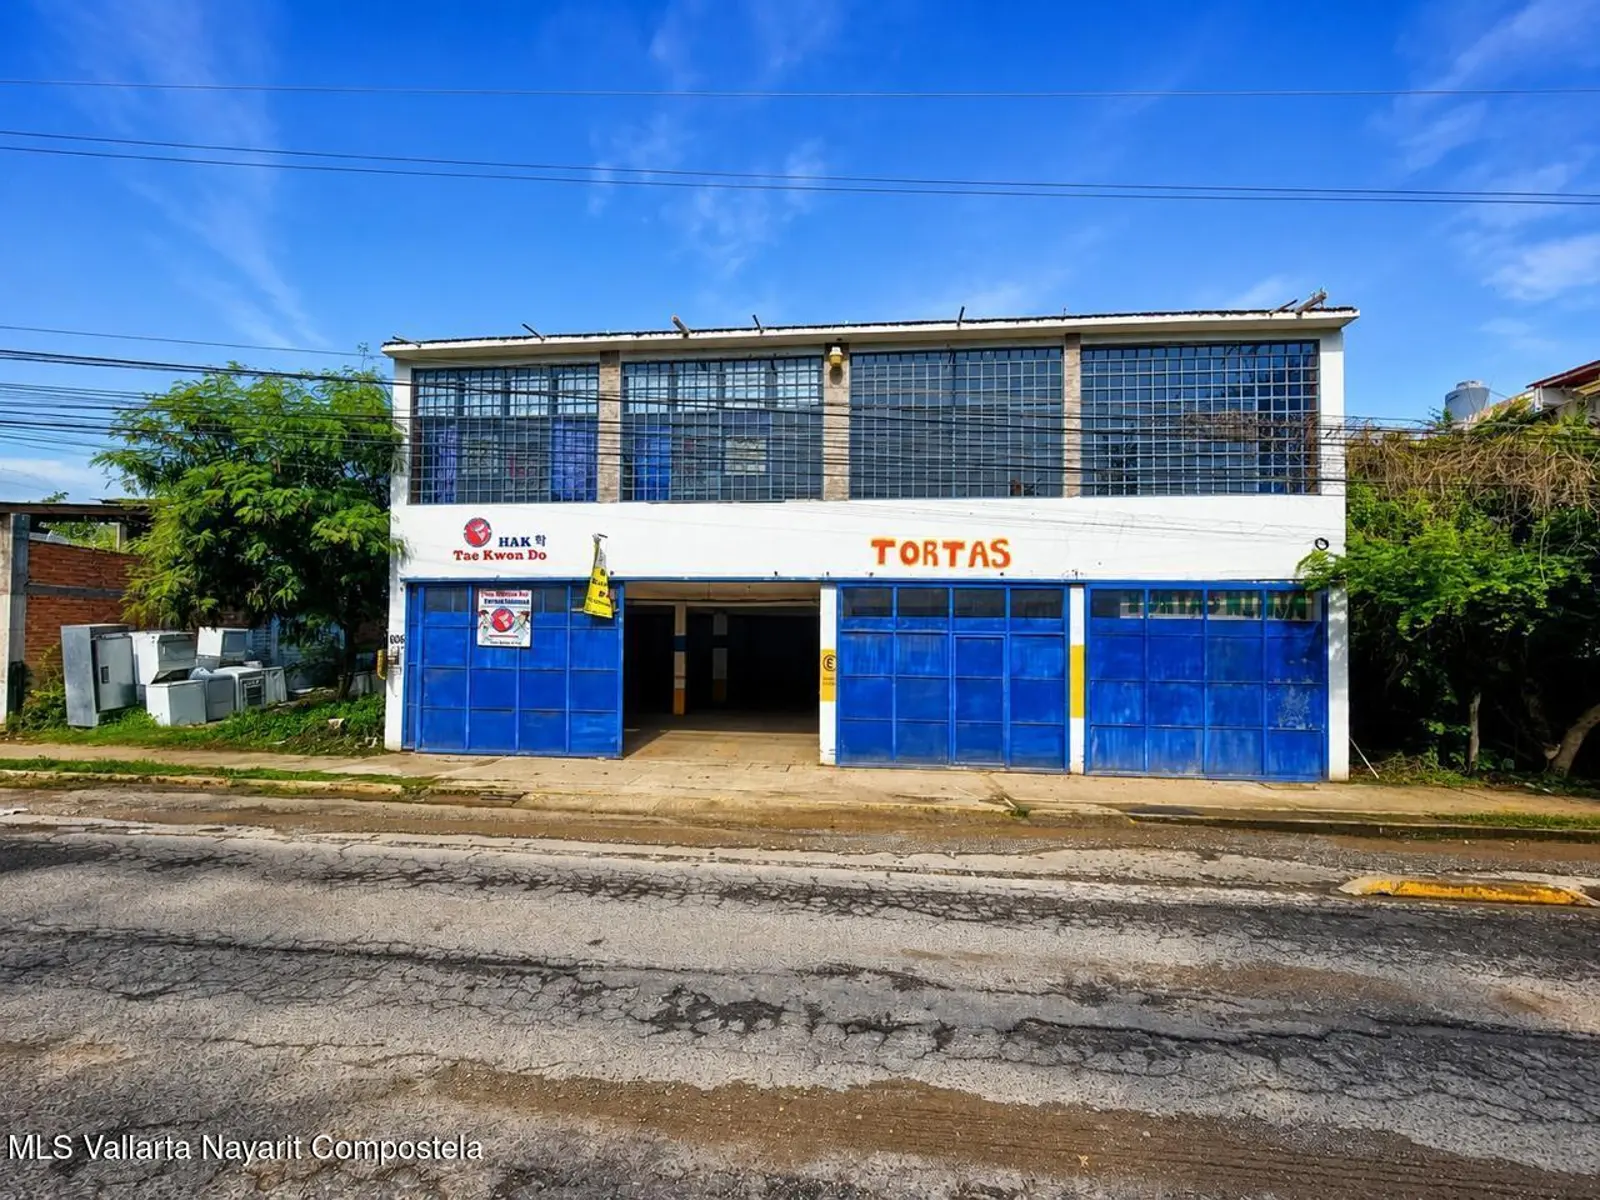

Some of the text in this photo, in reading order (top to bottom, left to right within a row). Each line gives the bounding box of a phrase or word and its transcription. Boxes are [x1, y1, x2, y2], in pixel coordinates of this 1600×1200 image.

[498, 536, 531, 547] HAK
[453, 549, 547, 561] Tae Kwon Do
[871, 539, 1011, 569] TORTAS
